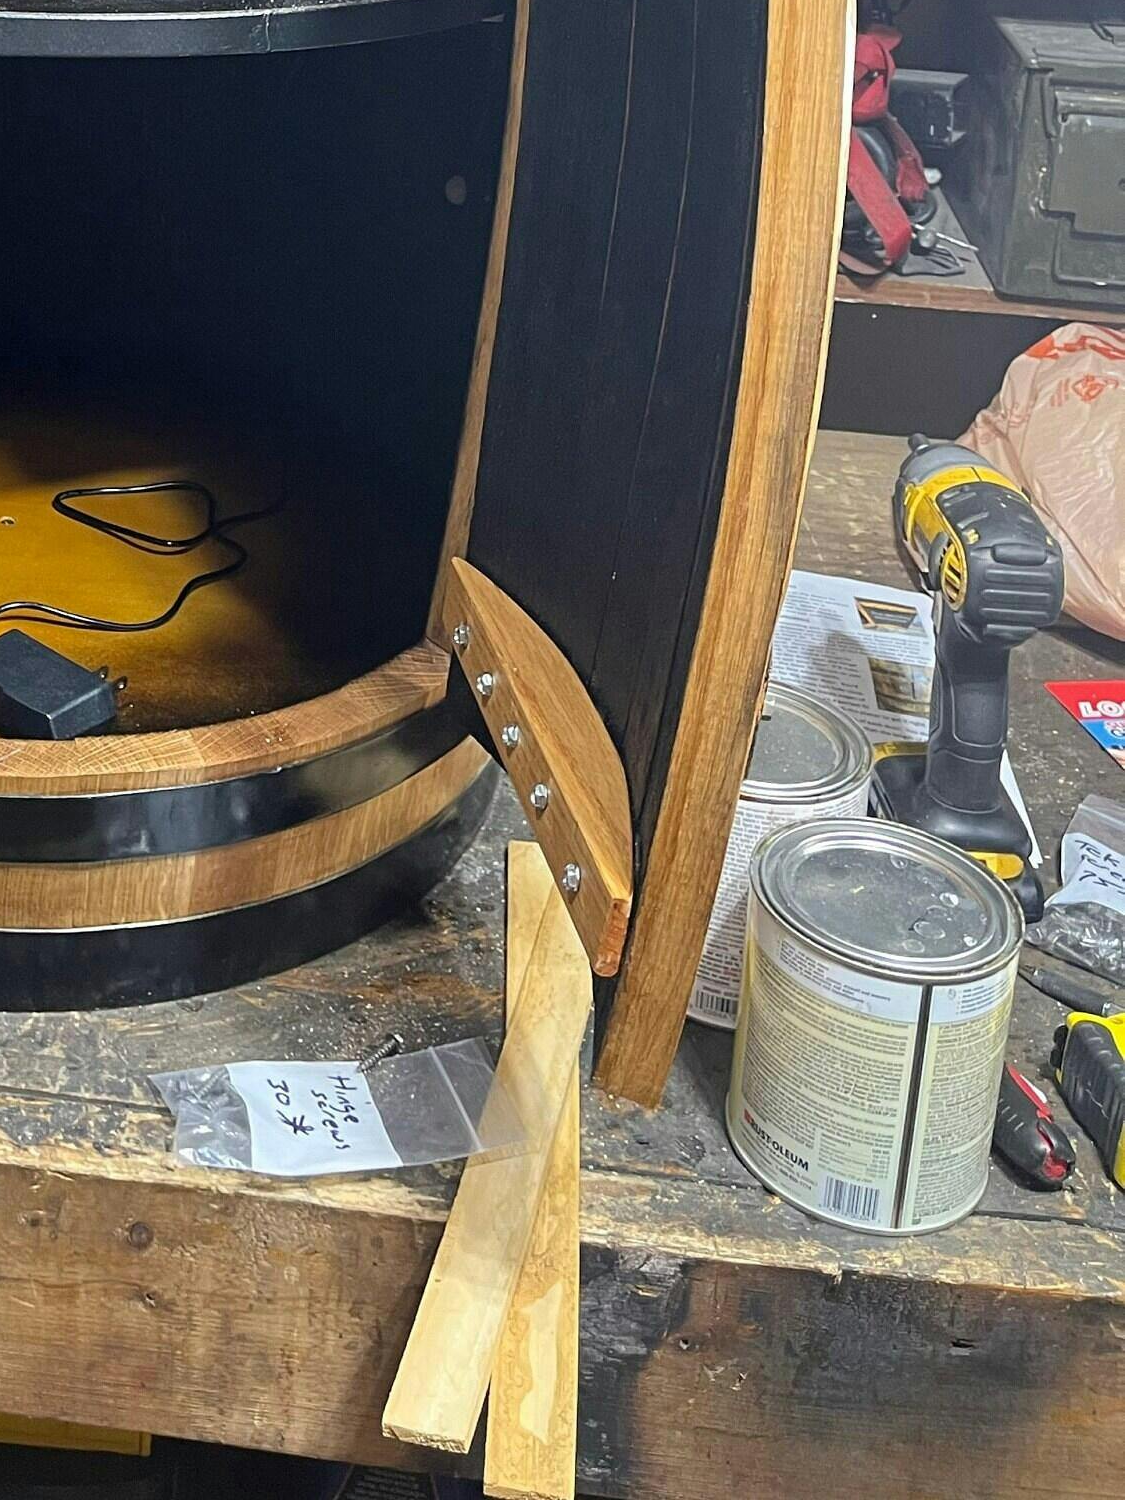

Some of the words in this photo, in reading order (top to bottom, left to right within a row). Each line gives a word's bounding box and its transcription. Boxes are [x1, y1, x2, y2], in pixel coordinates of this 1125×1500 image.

[1077, 700, 1125, 718] LO
[267, 1078, 291, 1106] 30
[327, 1075, 359, 1123] Hinge
[311, 1090, 351, 1150] screws
